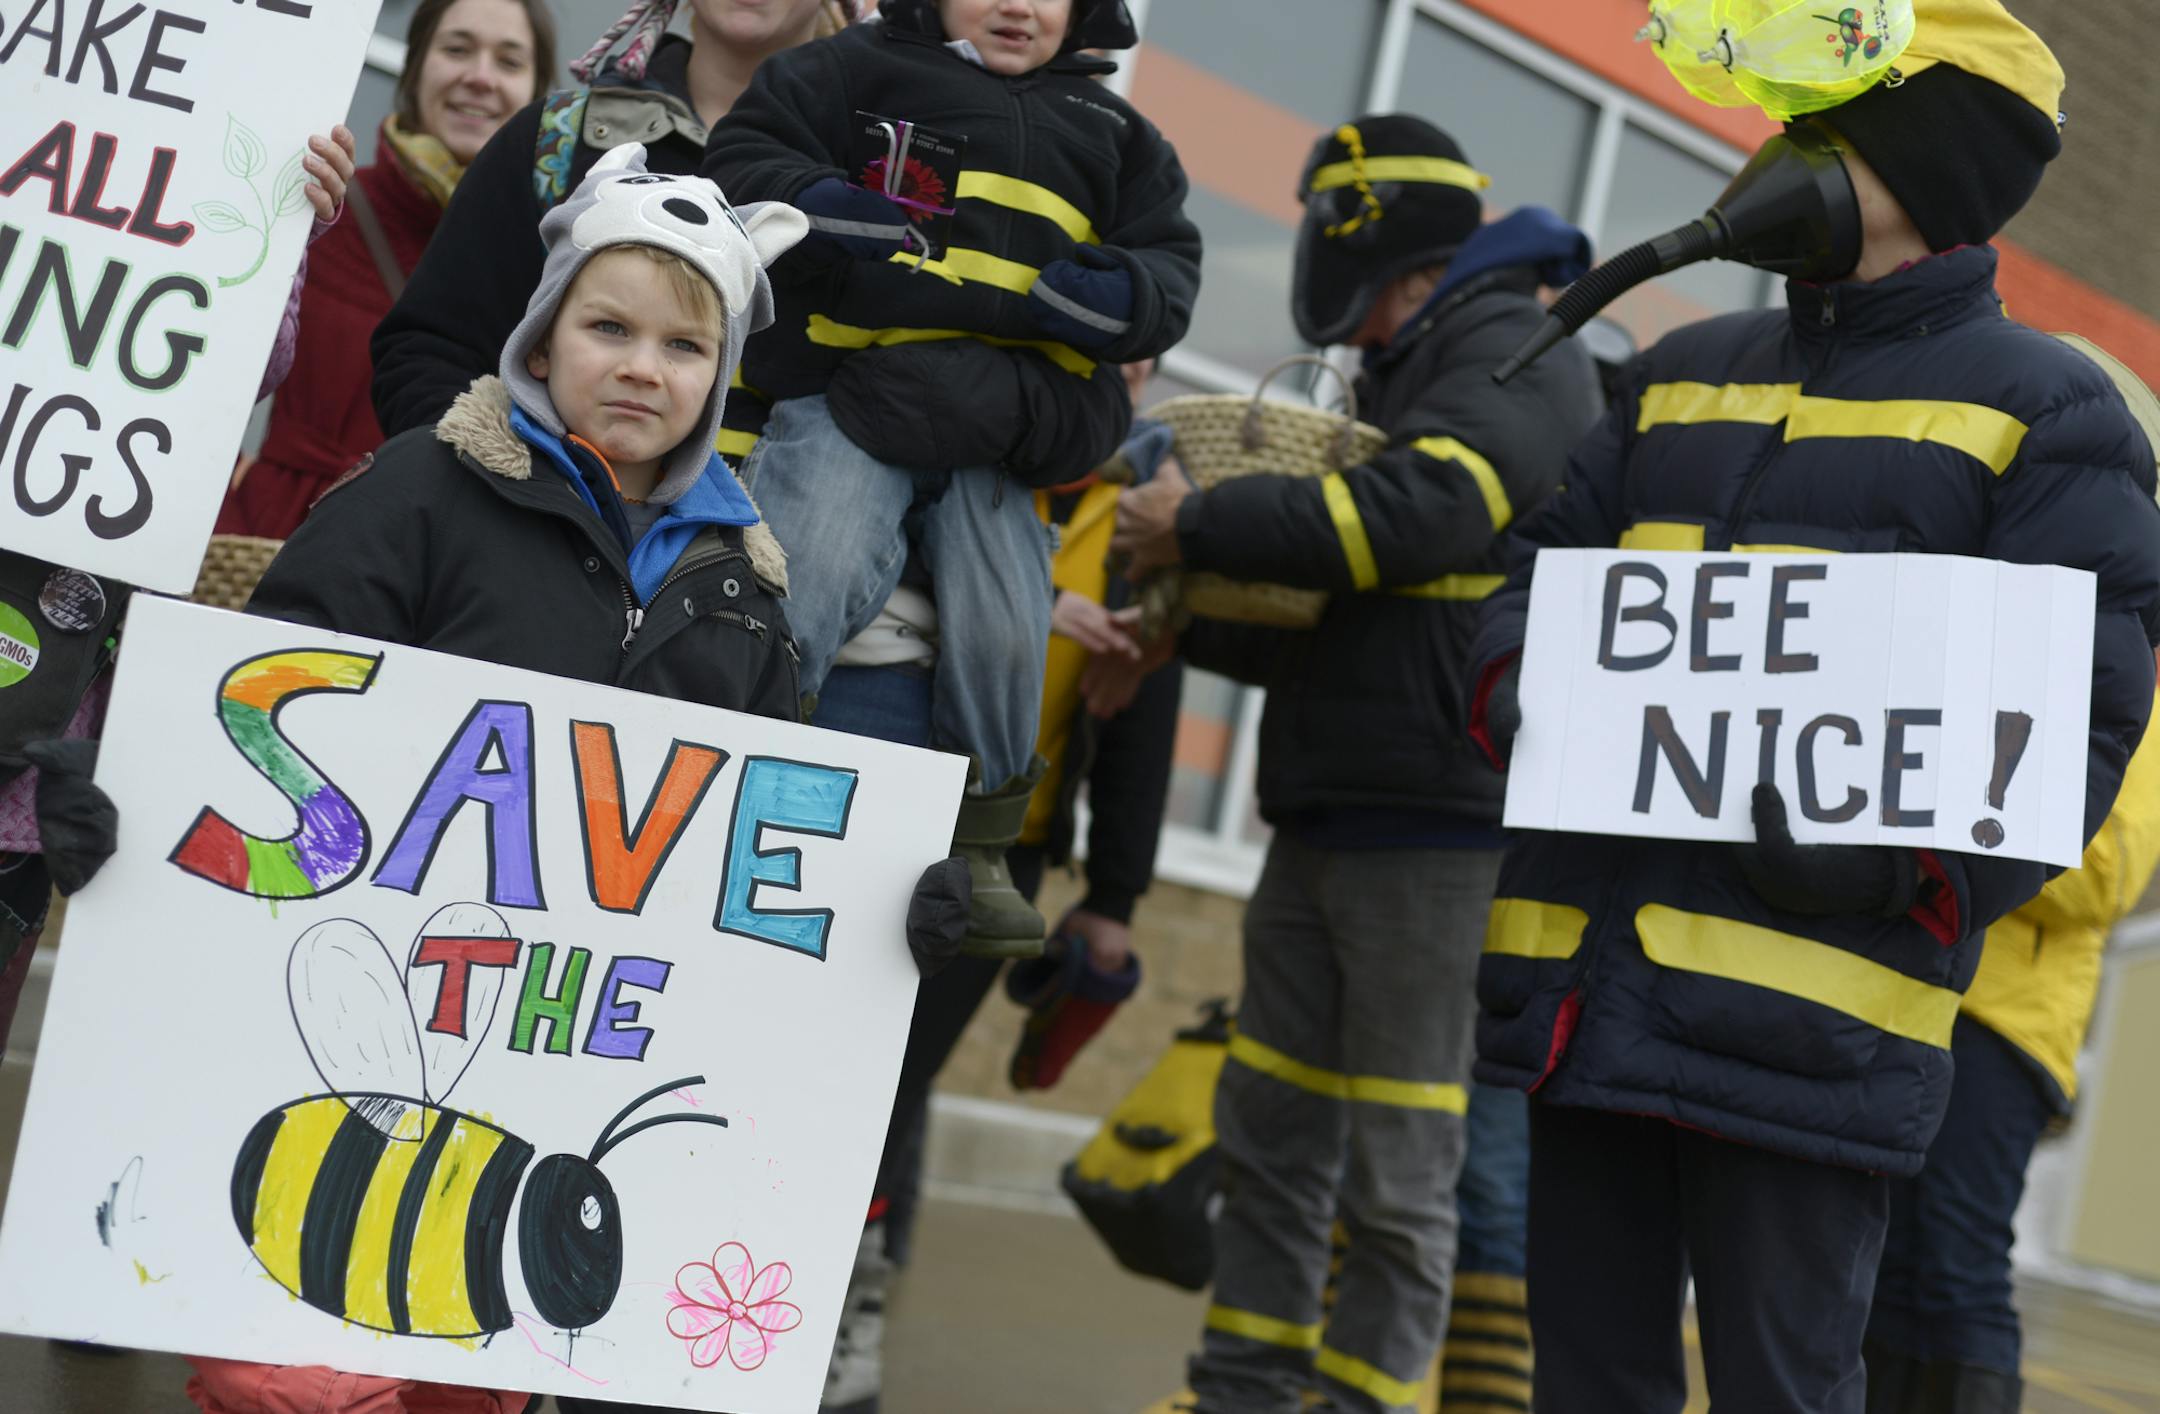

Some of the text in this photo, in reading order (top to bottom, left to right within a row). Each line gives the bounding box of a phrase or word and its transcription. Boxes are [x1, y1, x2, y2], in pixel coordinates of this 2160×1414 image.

[0, 0, 206, 114] AKE
[0, 120, 195, 247] ALL
[0, 224, 211, 393] NG
[0, 383, 172, 540] GS
[1597, 561, 1828, 675] BEE
[166, 647, 859, 962] SAVE
[411, 935, 675, 1062] THE
